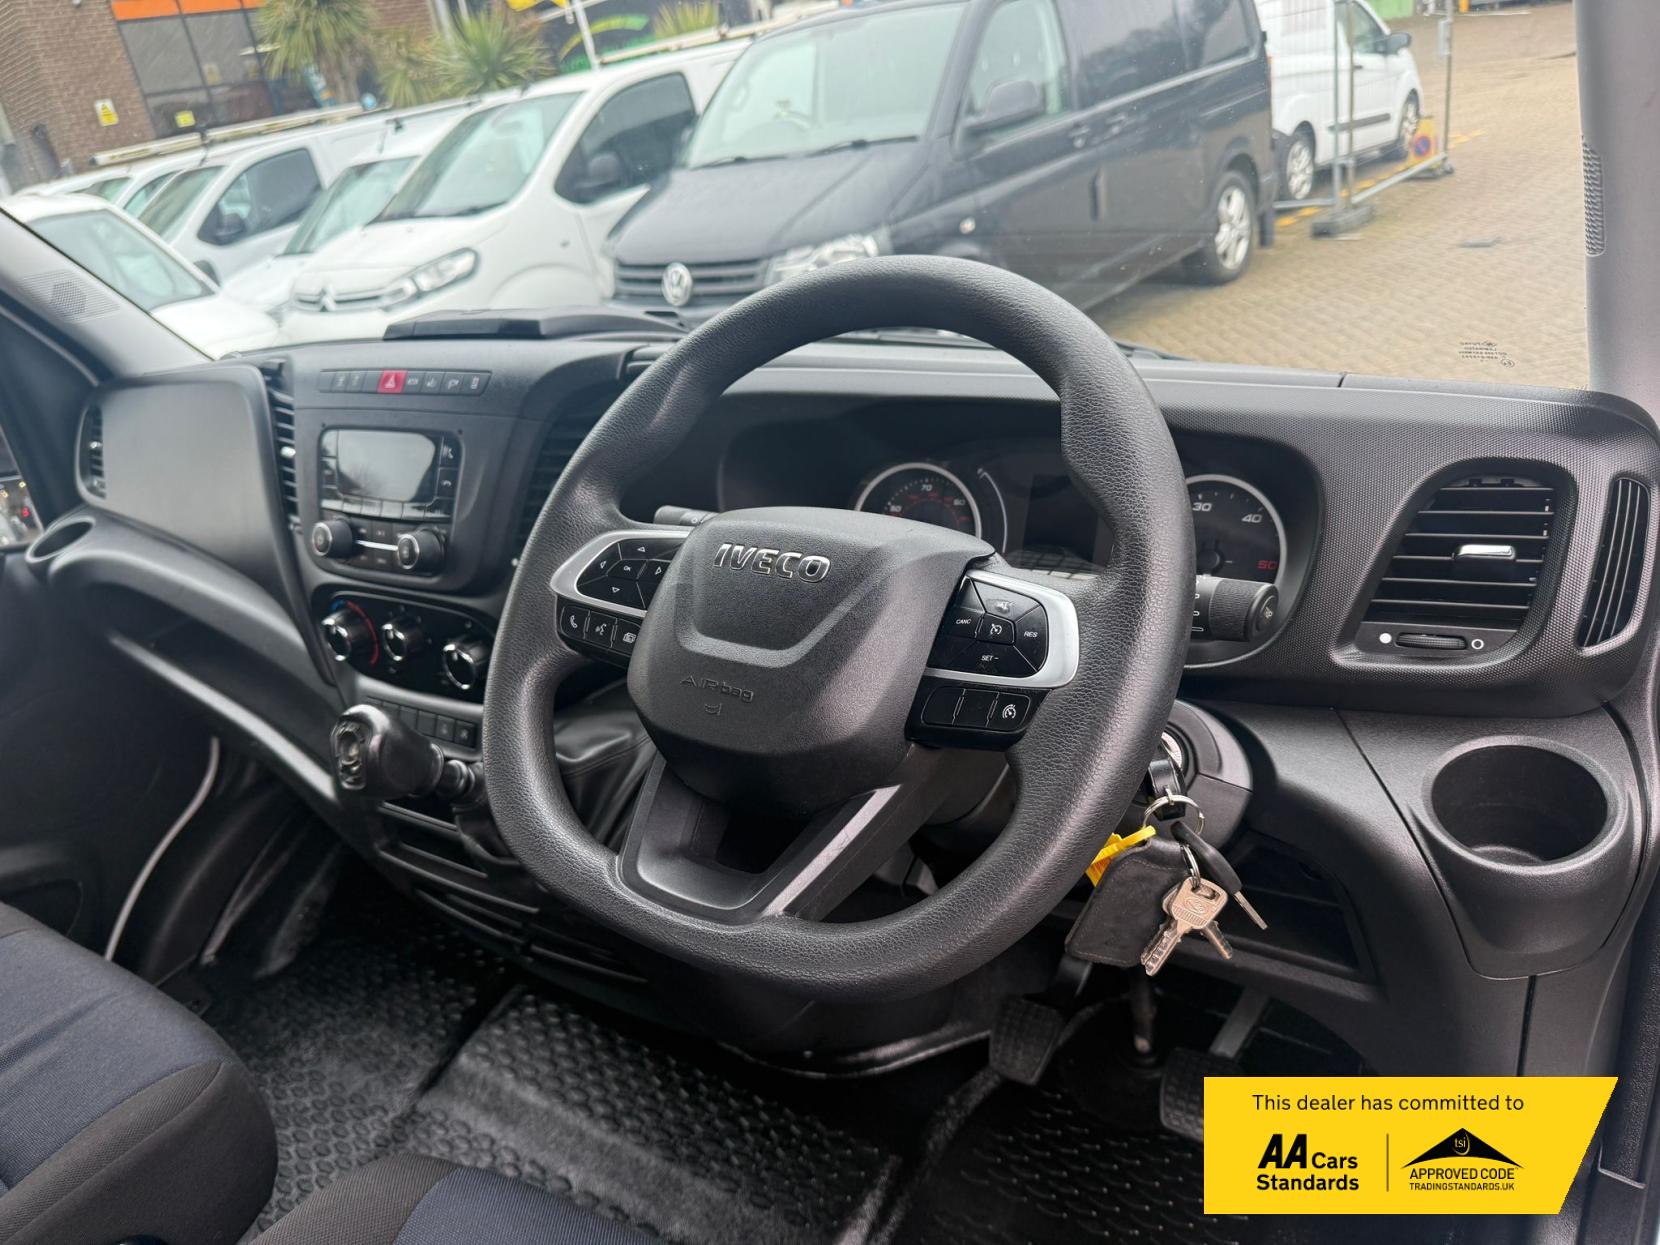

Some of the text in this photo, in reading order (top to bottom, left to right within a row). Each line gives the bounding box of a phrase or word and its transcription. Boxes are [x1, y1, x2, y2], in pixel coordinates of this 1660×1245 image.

[1192, 502, 1213, 512] 30
[1241, 514, 1262, 524] 40
[713, 543, 831, 583] IVECO
[1257, 560, 1278, 570] 50
